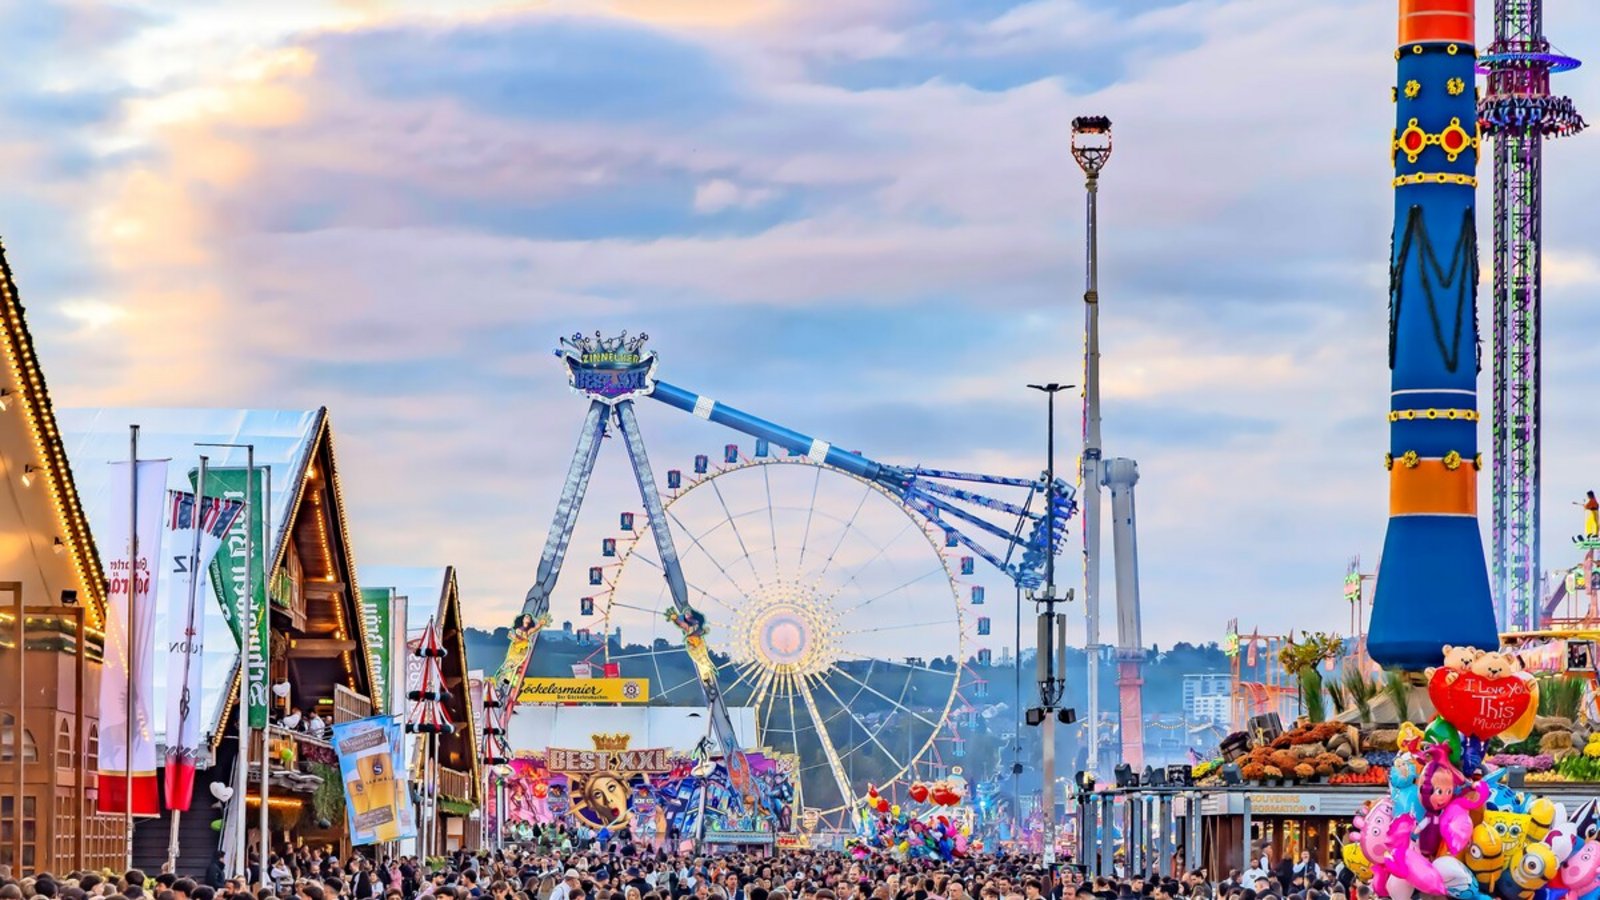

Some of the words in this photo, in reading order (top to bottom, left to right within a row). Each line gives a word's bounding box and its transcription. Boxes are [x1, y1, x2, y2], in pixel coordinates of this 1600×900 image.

[1464, 679, 1475, 692] I
[1479, 680, 1506, 694] Love
[1472, 694, 1514, 719] This
[550, 749, 609, 771] BEST
[618, 749, 672, 771] XXL
